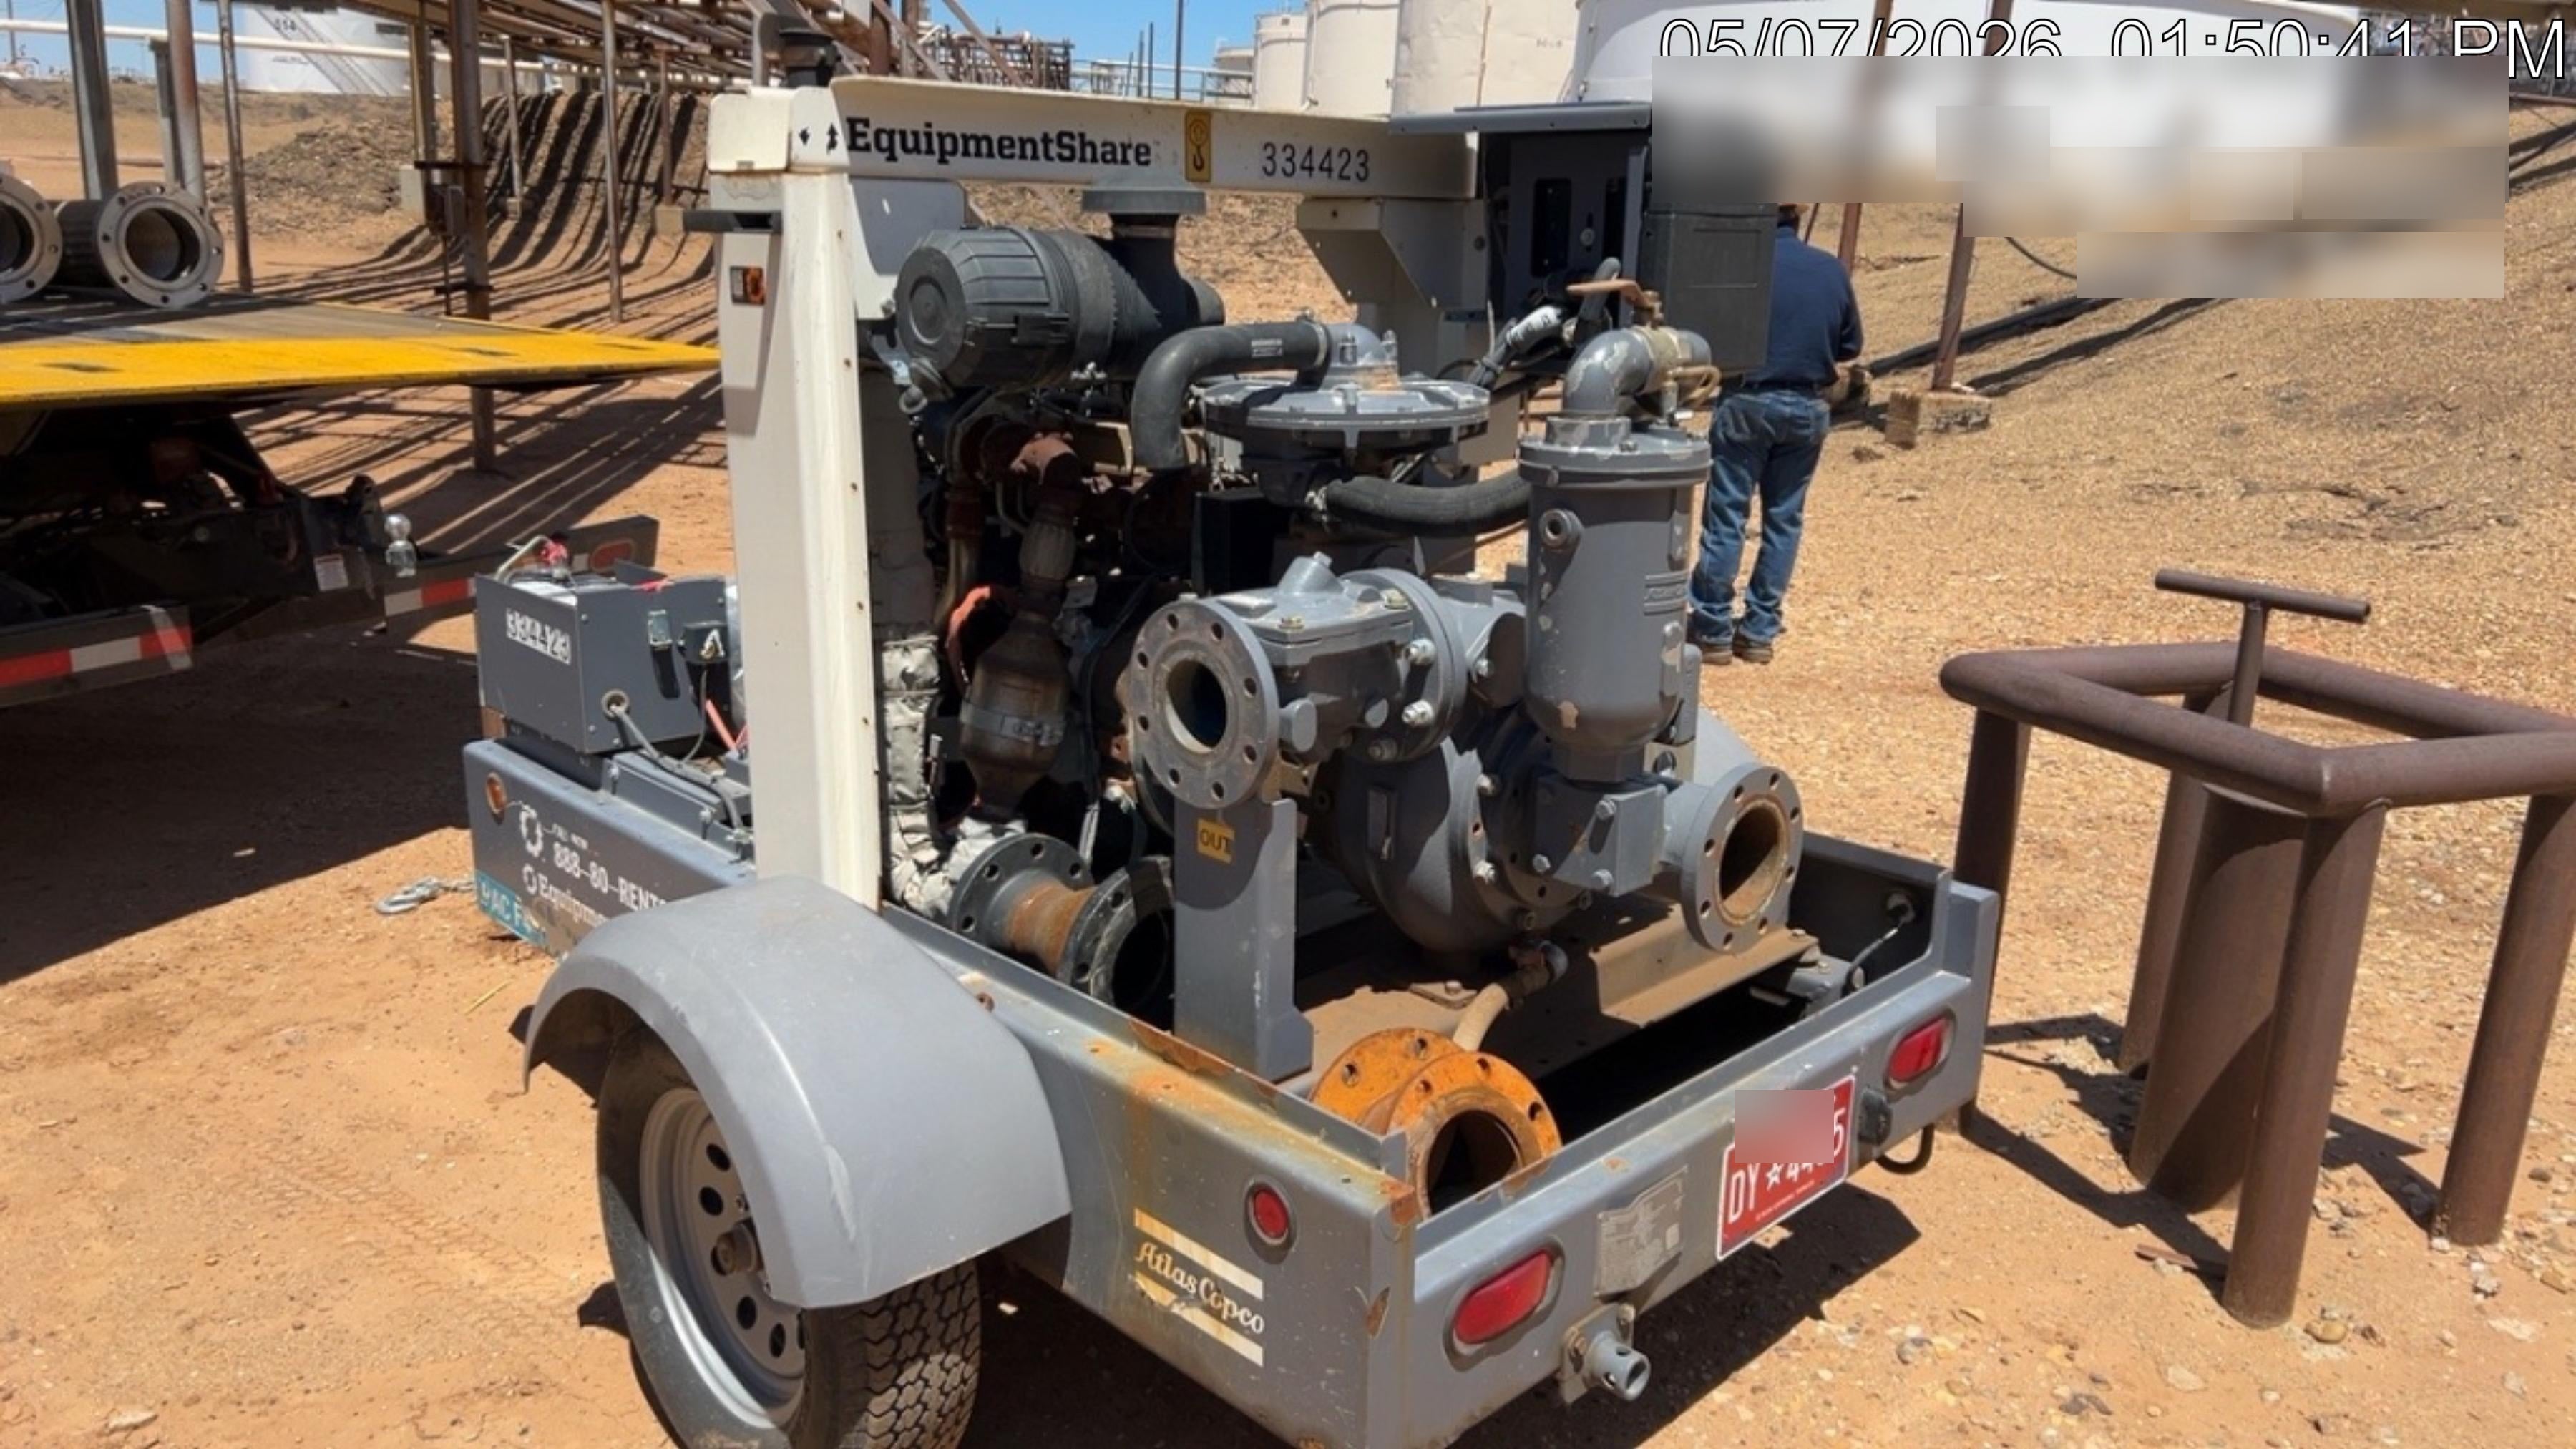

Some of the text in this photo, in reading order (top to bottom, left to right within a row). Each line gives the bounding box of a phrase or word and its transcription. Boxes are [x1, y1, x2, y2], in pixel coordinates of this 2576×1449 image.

[846, 117, 1151, 165] EquipmentShare
[1262, 142, 1370, 182] 334423
[1200, 828, 1231, 854] OUT
[1136, 1241, 1265, 1334] Atlas Copco
